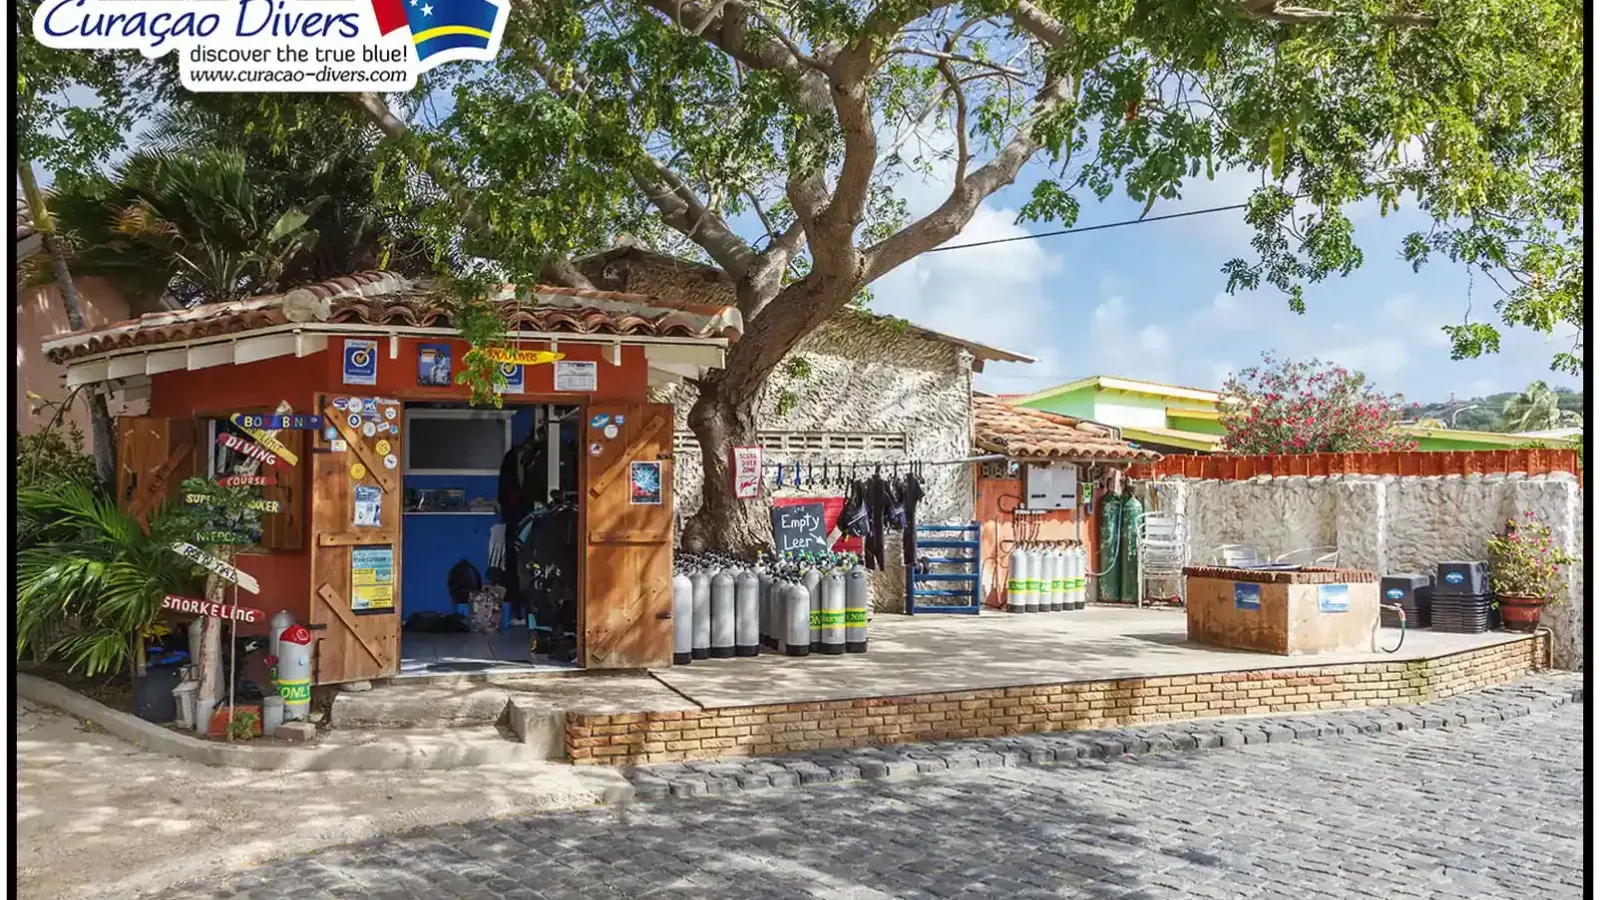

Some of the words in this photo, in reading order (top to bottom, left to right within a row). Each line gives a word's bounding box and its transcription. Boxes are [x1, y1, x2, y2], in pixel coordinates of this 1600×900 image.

[225, 435, 277, 465] DIVING
[226, 475, 267, 486] COURSE
[781, 512, 820, 532] Empty
[783, 534, 812, 550] Leer
